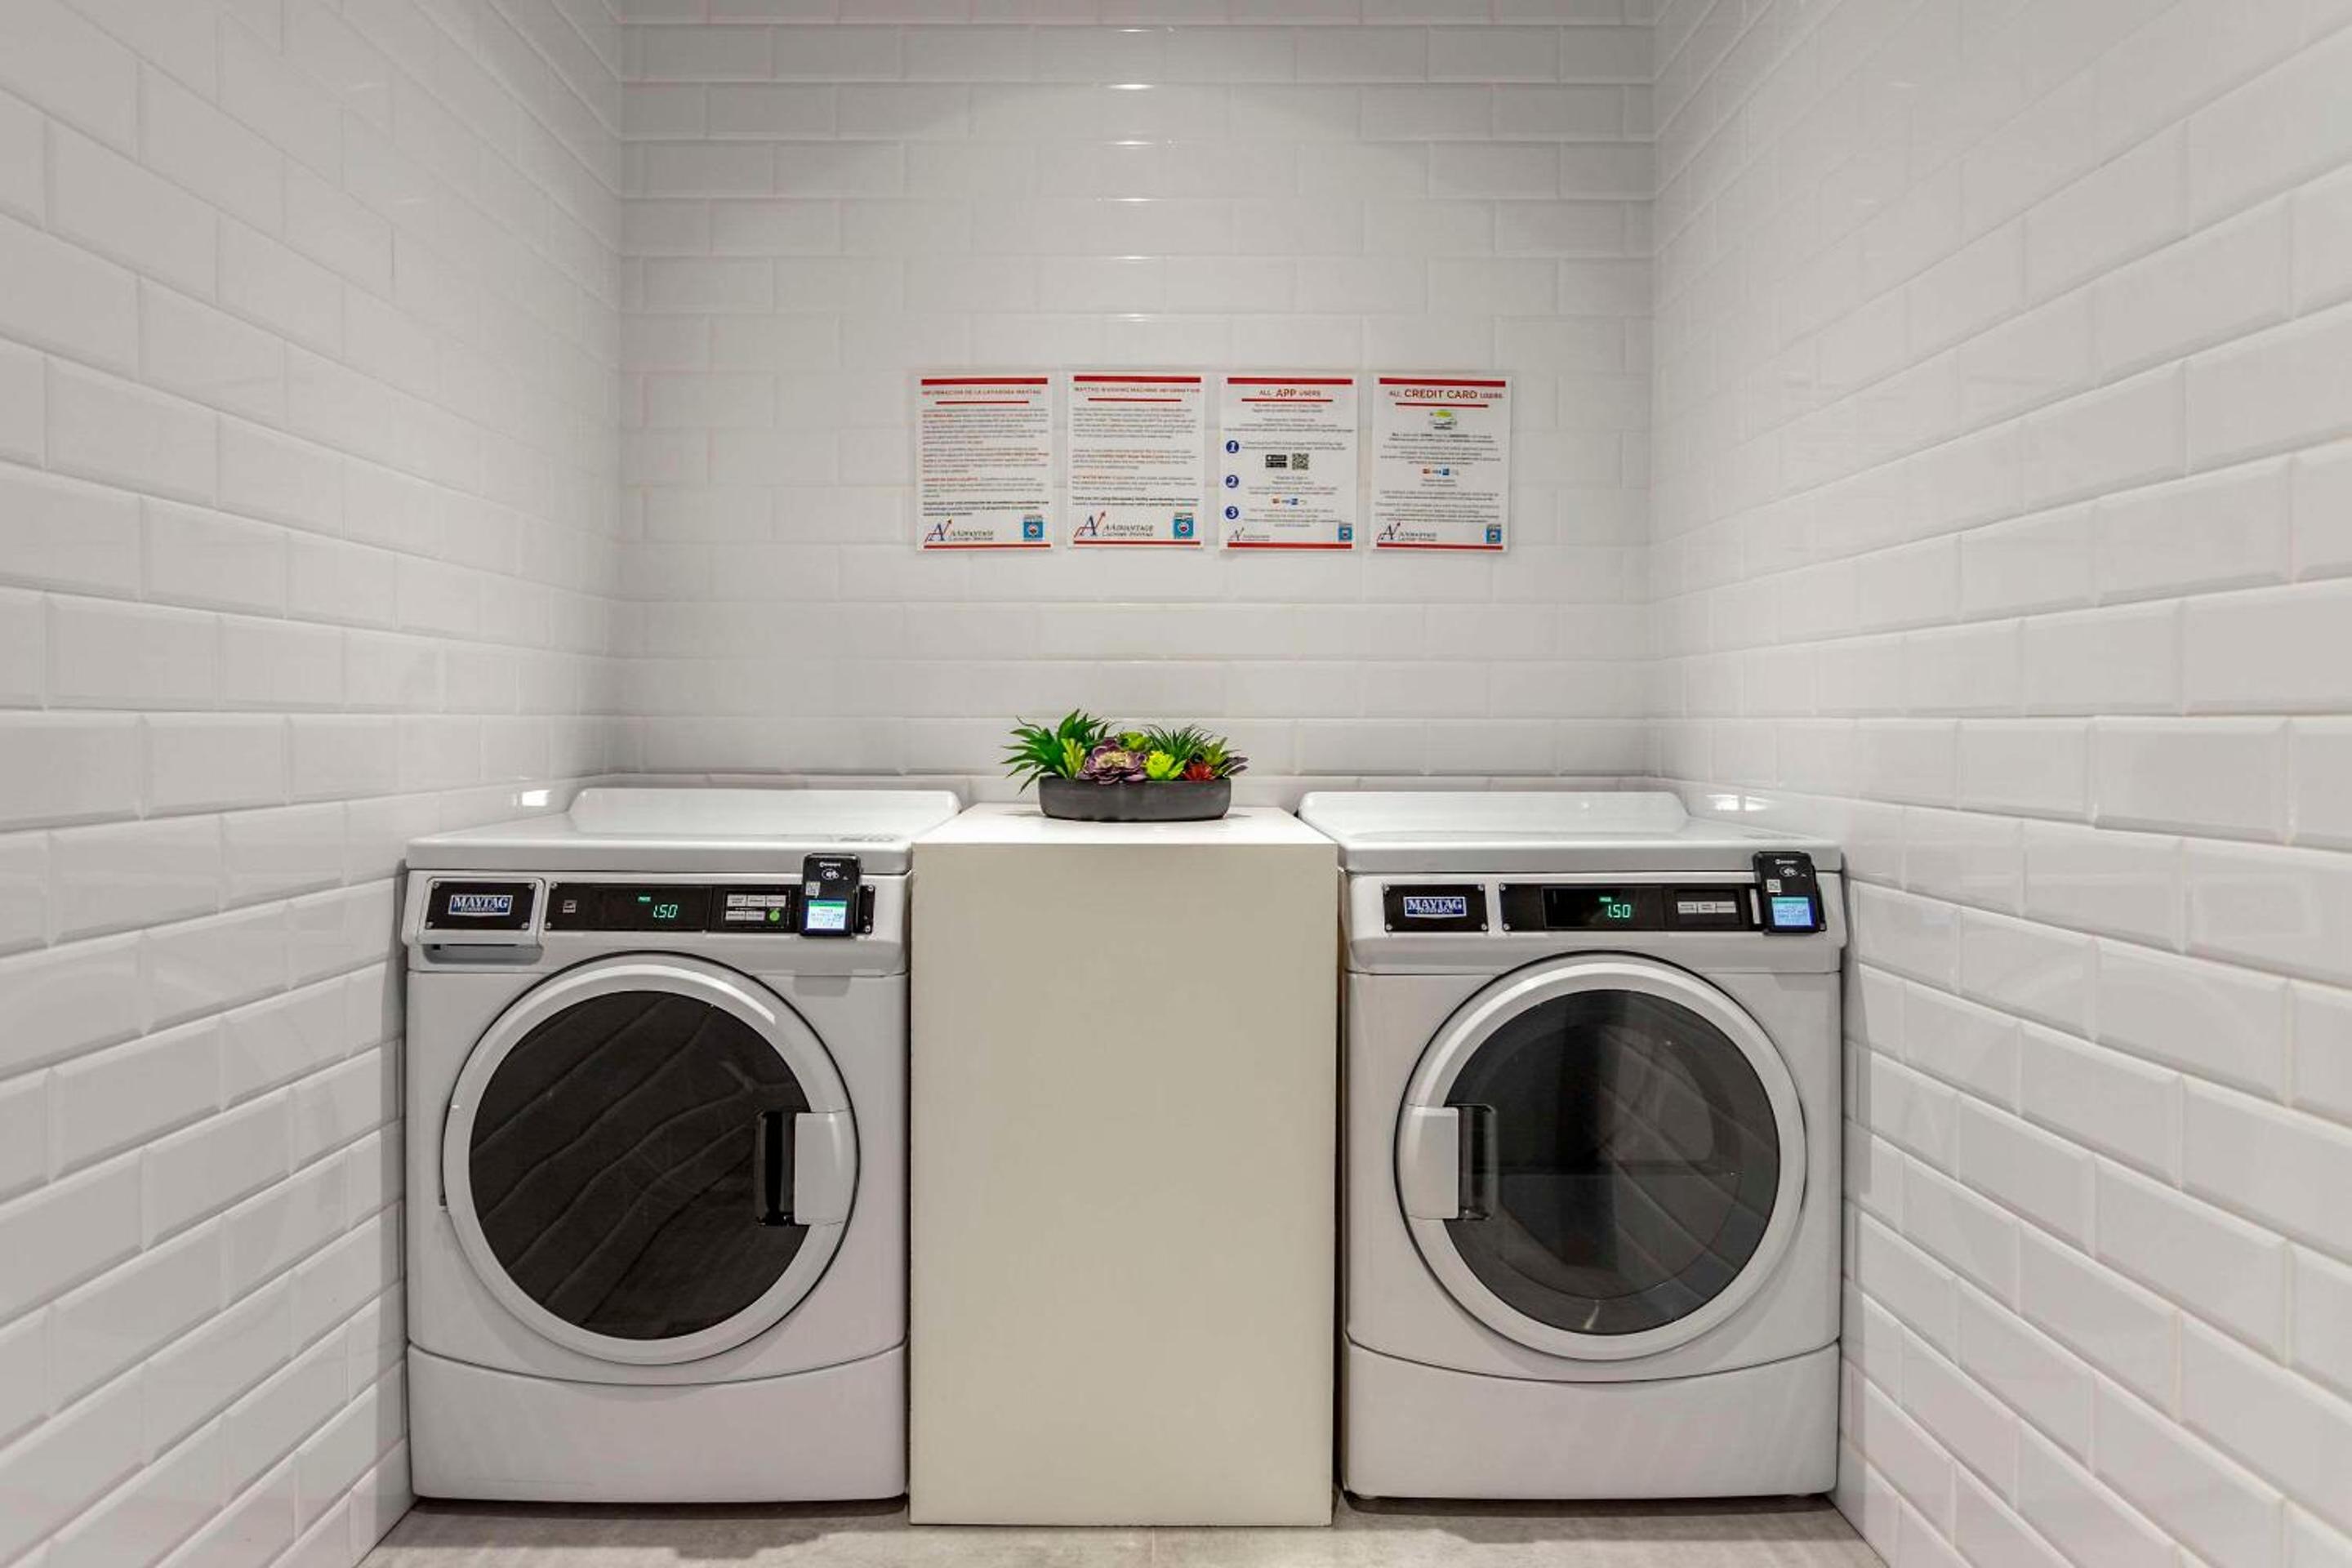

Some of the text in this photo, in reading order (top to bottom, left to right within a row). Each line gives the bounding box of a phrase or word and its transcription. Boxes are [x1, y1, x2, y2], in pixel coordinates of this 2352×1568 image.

[1276, 388, 1297, 397] APP
[1405, 388, 1445, 399] CREDIT
[1447, 390, 1477, 399] CARD
[453, 897, 509, 909] MAYTAG
[1407, 899, 1462, 911] MAYTAG
